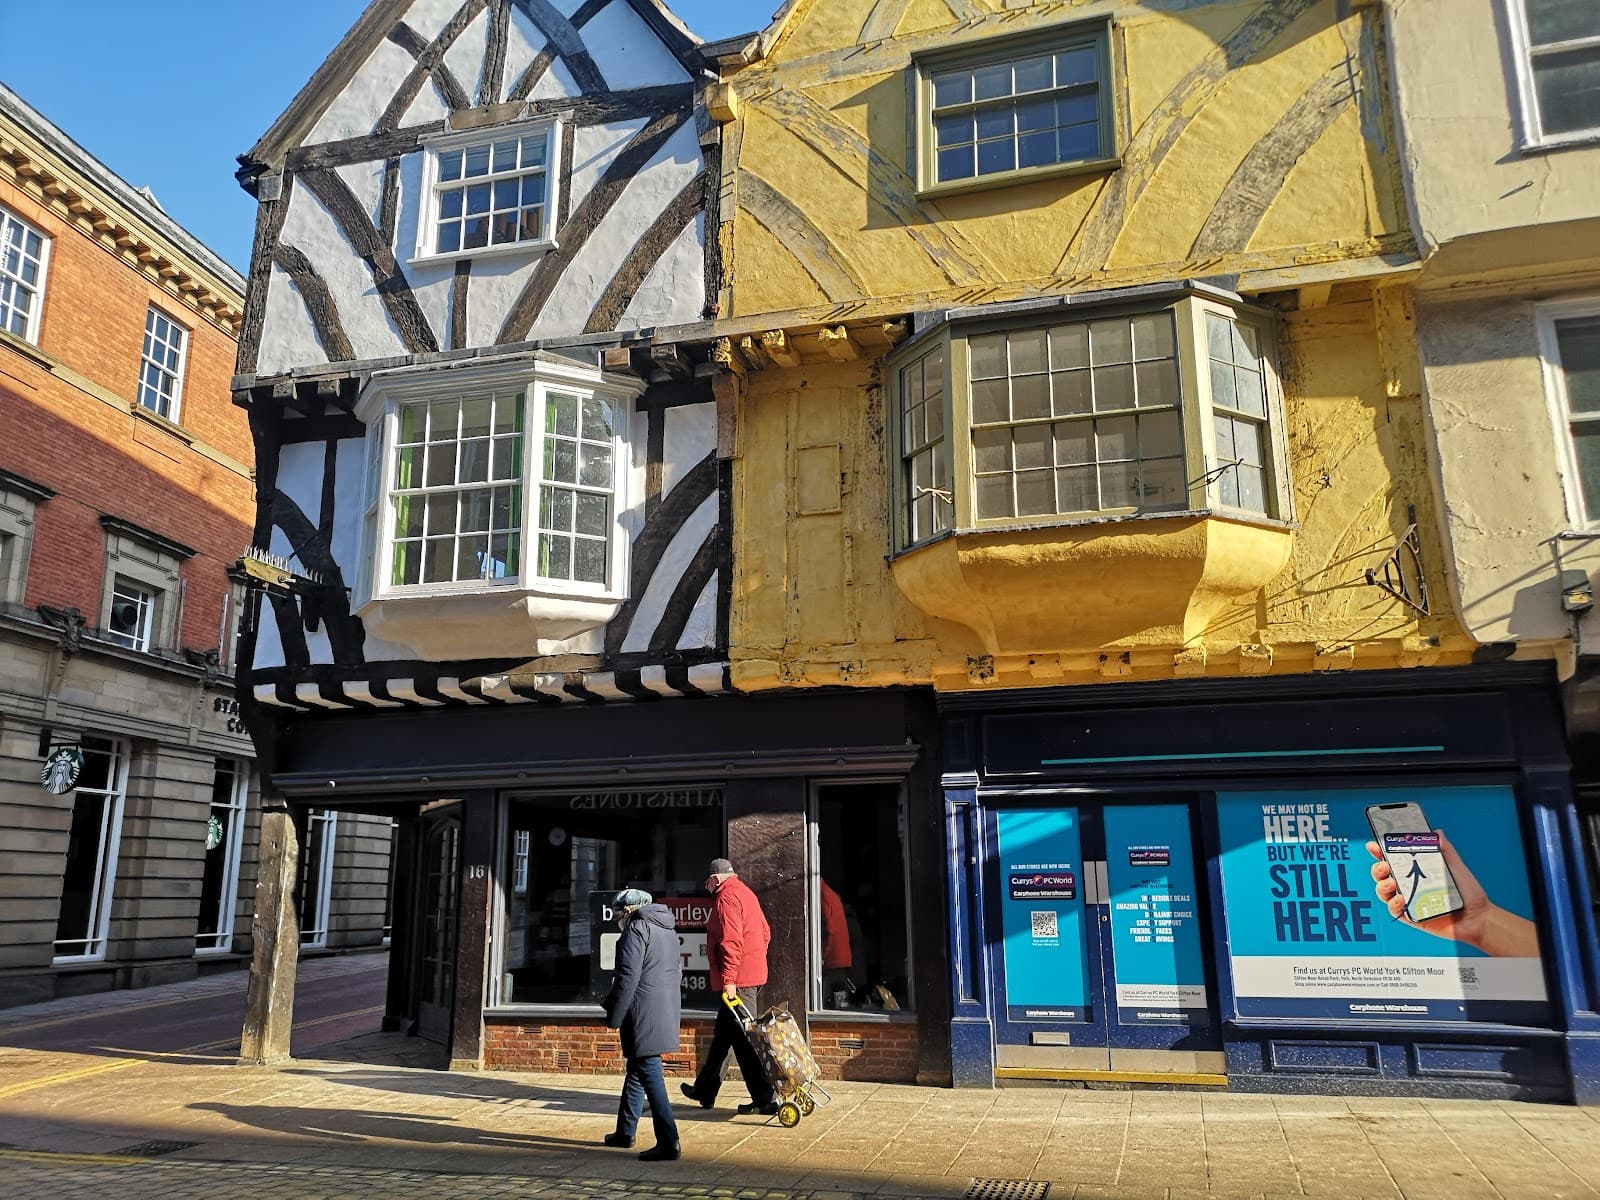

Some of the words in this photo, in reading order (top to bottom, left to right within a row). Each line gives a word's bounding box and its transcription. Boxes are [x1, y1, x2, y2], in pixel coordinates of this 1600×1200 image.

[1262, 804, 1276, 815] WE
[1278, 804, 1296, 815] MAY
[1298, 804, 1314, 814] NOT
[1316, 804, 1328, 814] BE
[1266, 844, 1296, 862] BUT
[1300, 844, 1350, 861] WE'RE
[470, 865, 484, 879] 16
[1269, 863, 1358, 899] STILL
[1272, 900, 1377, 942] HERE
[1293, 966, 1308, 975] Find
[1328, 967, 1350, 977] Currys
